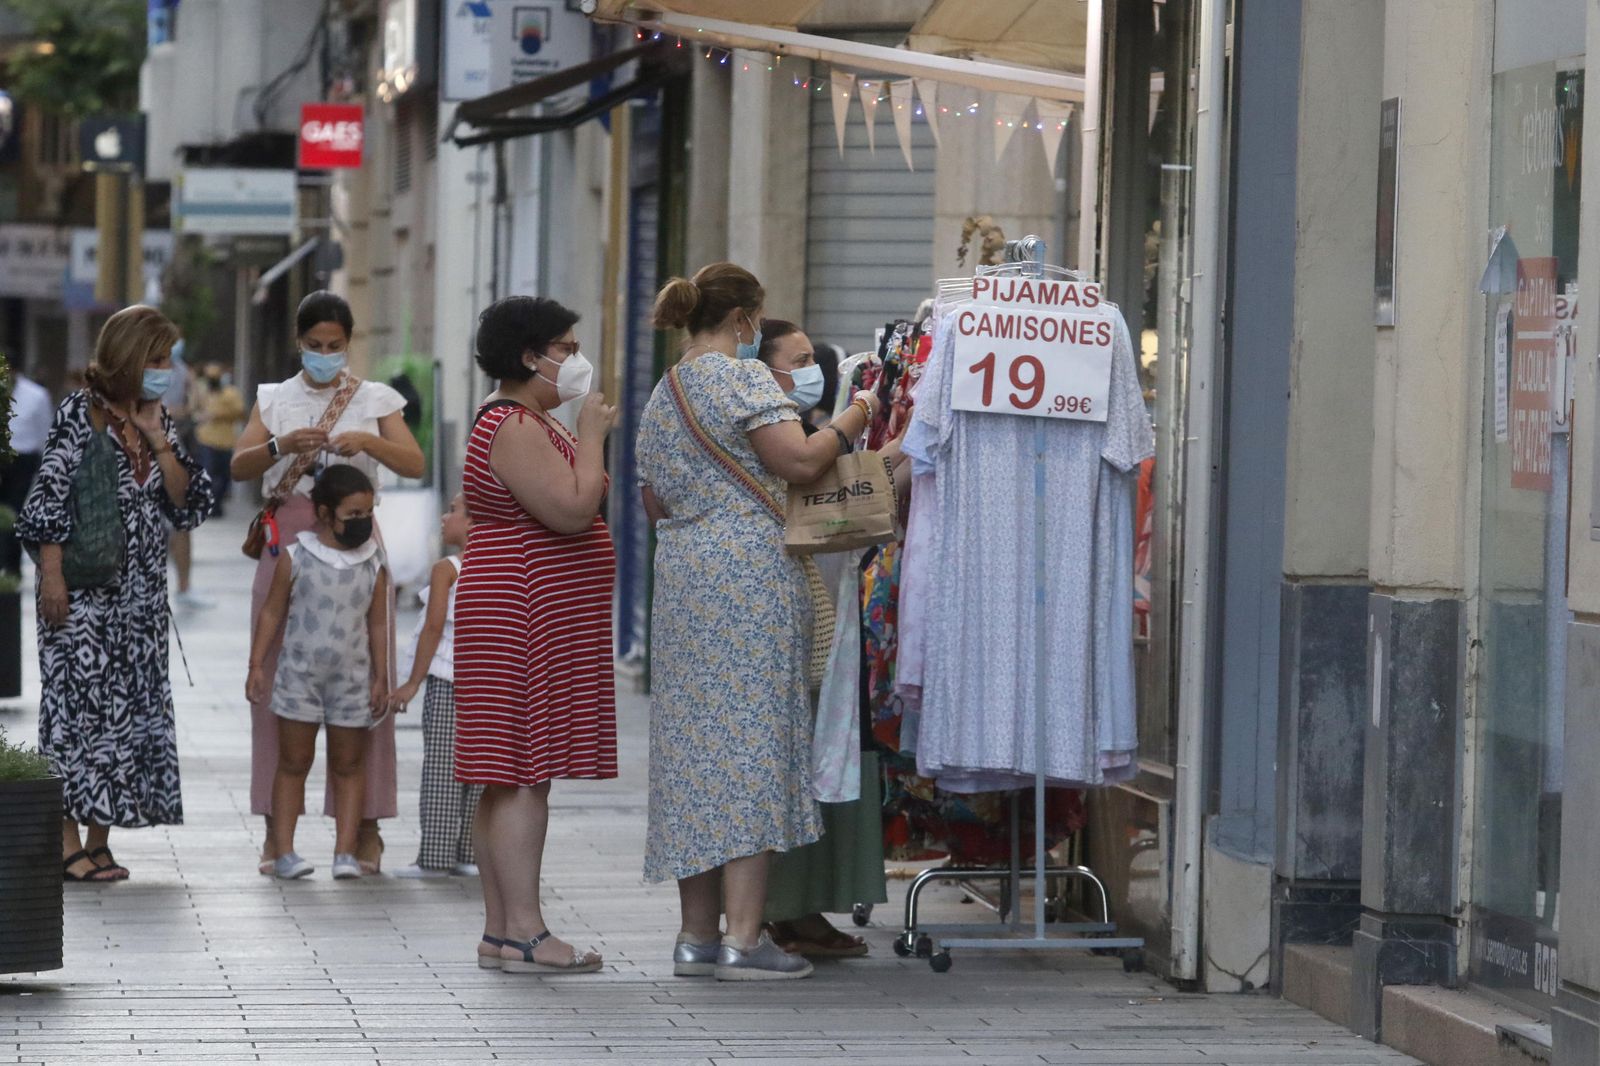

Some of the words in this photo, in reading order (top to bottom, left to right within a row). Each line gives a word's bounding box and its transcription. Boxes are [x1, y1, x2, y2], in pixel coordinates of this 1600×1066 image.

[301, 120, 362, 143] GAES
[1521, 84, 1565, 197] rebajas
[972, 277, 1100, 308] PIJAMAS
[958, 311, 1111, 347] CAMISONES
[1517, 350, 1551, 393] ALQUILA
